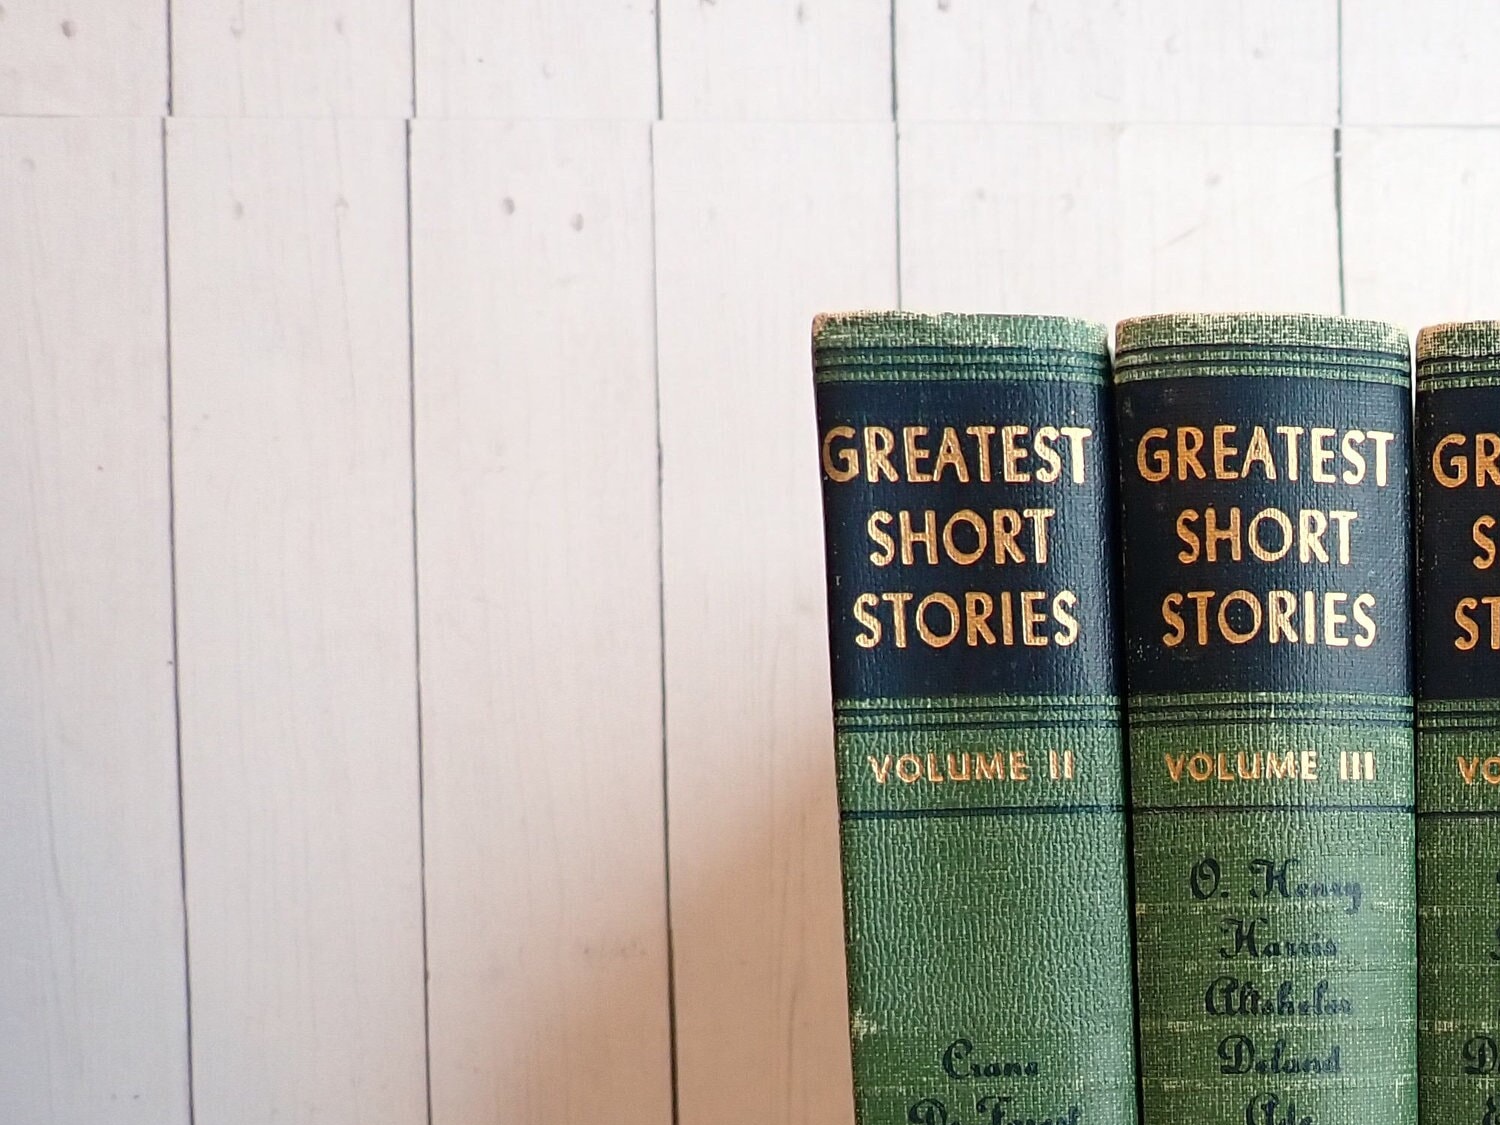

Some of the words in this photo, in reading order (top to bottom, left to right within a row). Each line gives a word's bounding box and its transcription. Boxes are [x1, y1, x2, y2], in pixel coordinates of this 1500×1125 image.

[822, 425, 1092, 484] GREATEST
[1136, 425, 1394, 487] GREATEST
[866, 508, 1054, 567] SHORT
[1176, 506, 1357, 564] SHORT
[853, 590, 1080, 649] STORIES
[1161, 589, 1376, 648] STORIES
[868, 750, 1030, 785] VOLUME
[1048, 750, 1076, 781] II
[1164, 749, 1318, 784] VOLUME
[1339, 752, 1375, 781] III
[1190, 857, 1230, 900] O.
[1250, 858, 1363, 915] Henry
[1219, 917, 1338, 959] Harris
[942, 1038, 1039, 1080] Crane
